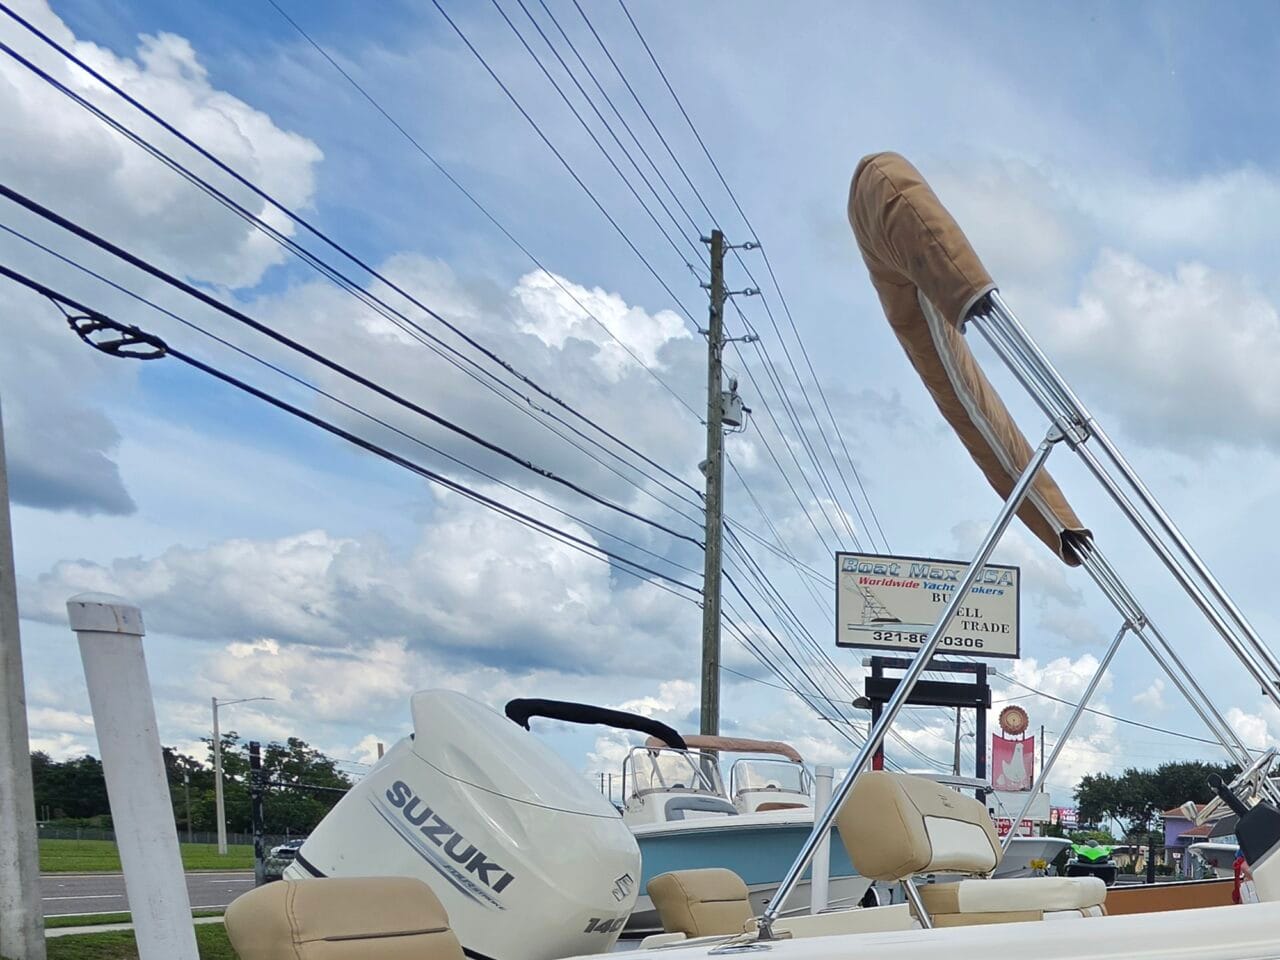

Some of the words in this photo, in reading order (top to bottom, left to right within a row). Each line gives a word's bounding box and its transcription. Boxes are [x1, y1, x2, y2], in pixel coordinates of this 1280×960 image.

[842, 558, 901, 576] Boat
[909, 563, 960, 580] Max
[858, 577, 920, 589] Worldwide
[923, 581, 956, 592] Yacht
[971, 586, 1004, 596] okers
[932, 592, 952, 603] BU
[956, 607, 983, 618] ELL
[961, 620, 1010, 634] TRADE
[873, 631, 984, 648] 321-86-0306
[386, 780, 515, 894] SUZUKI
